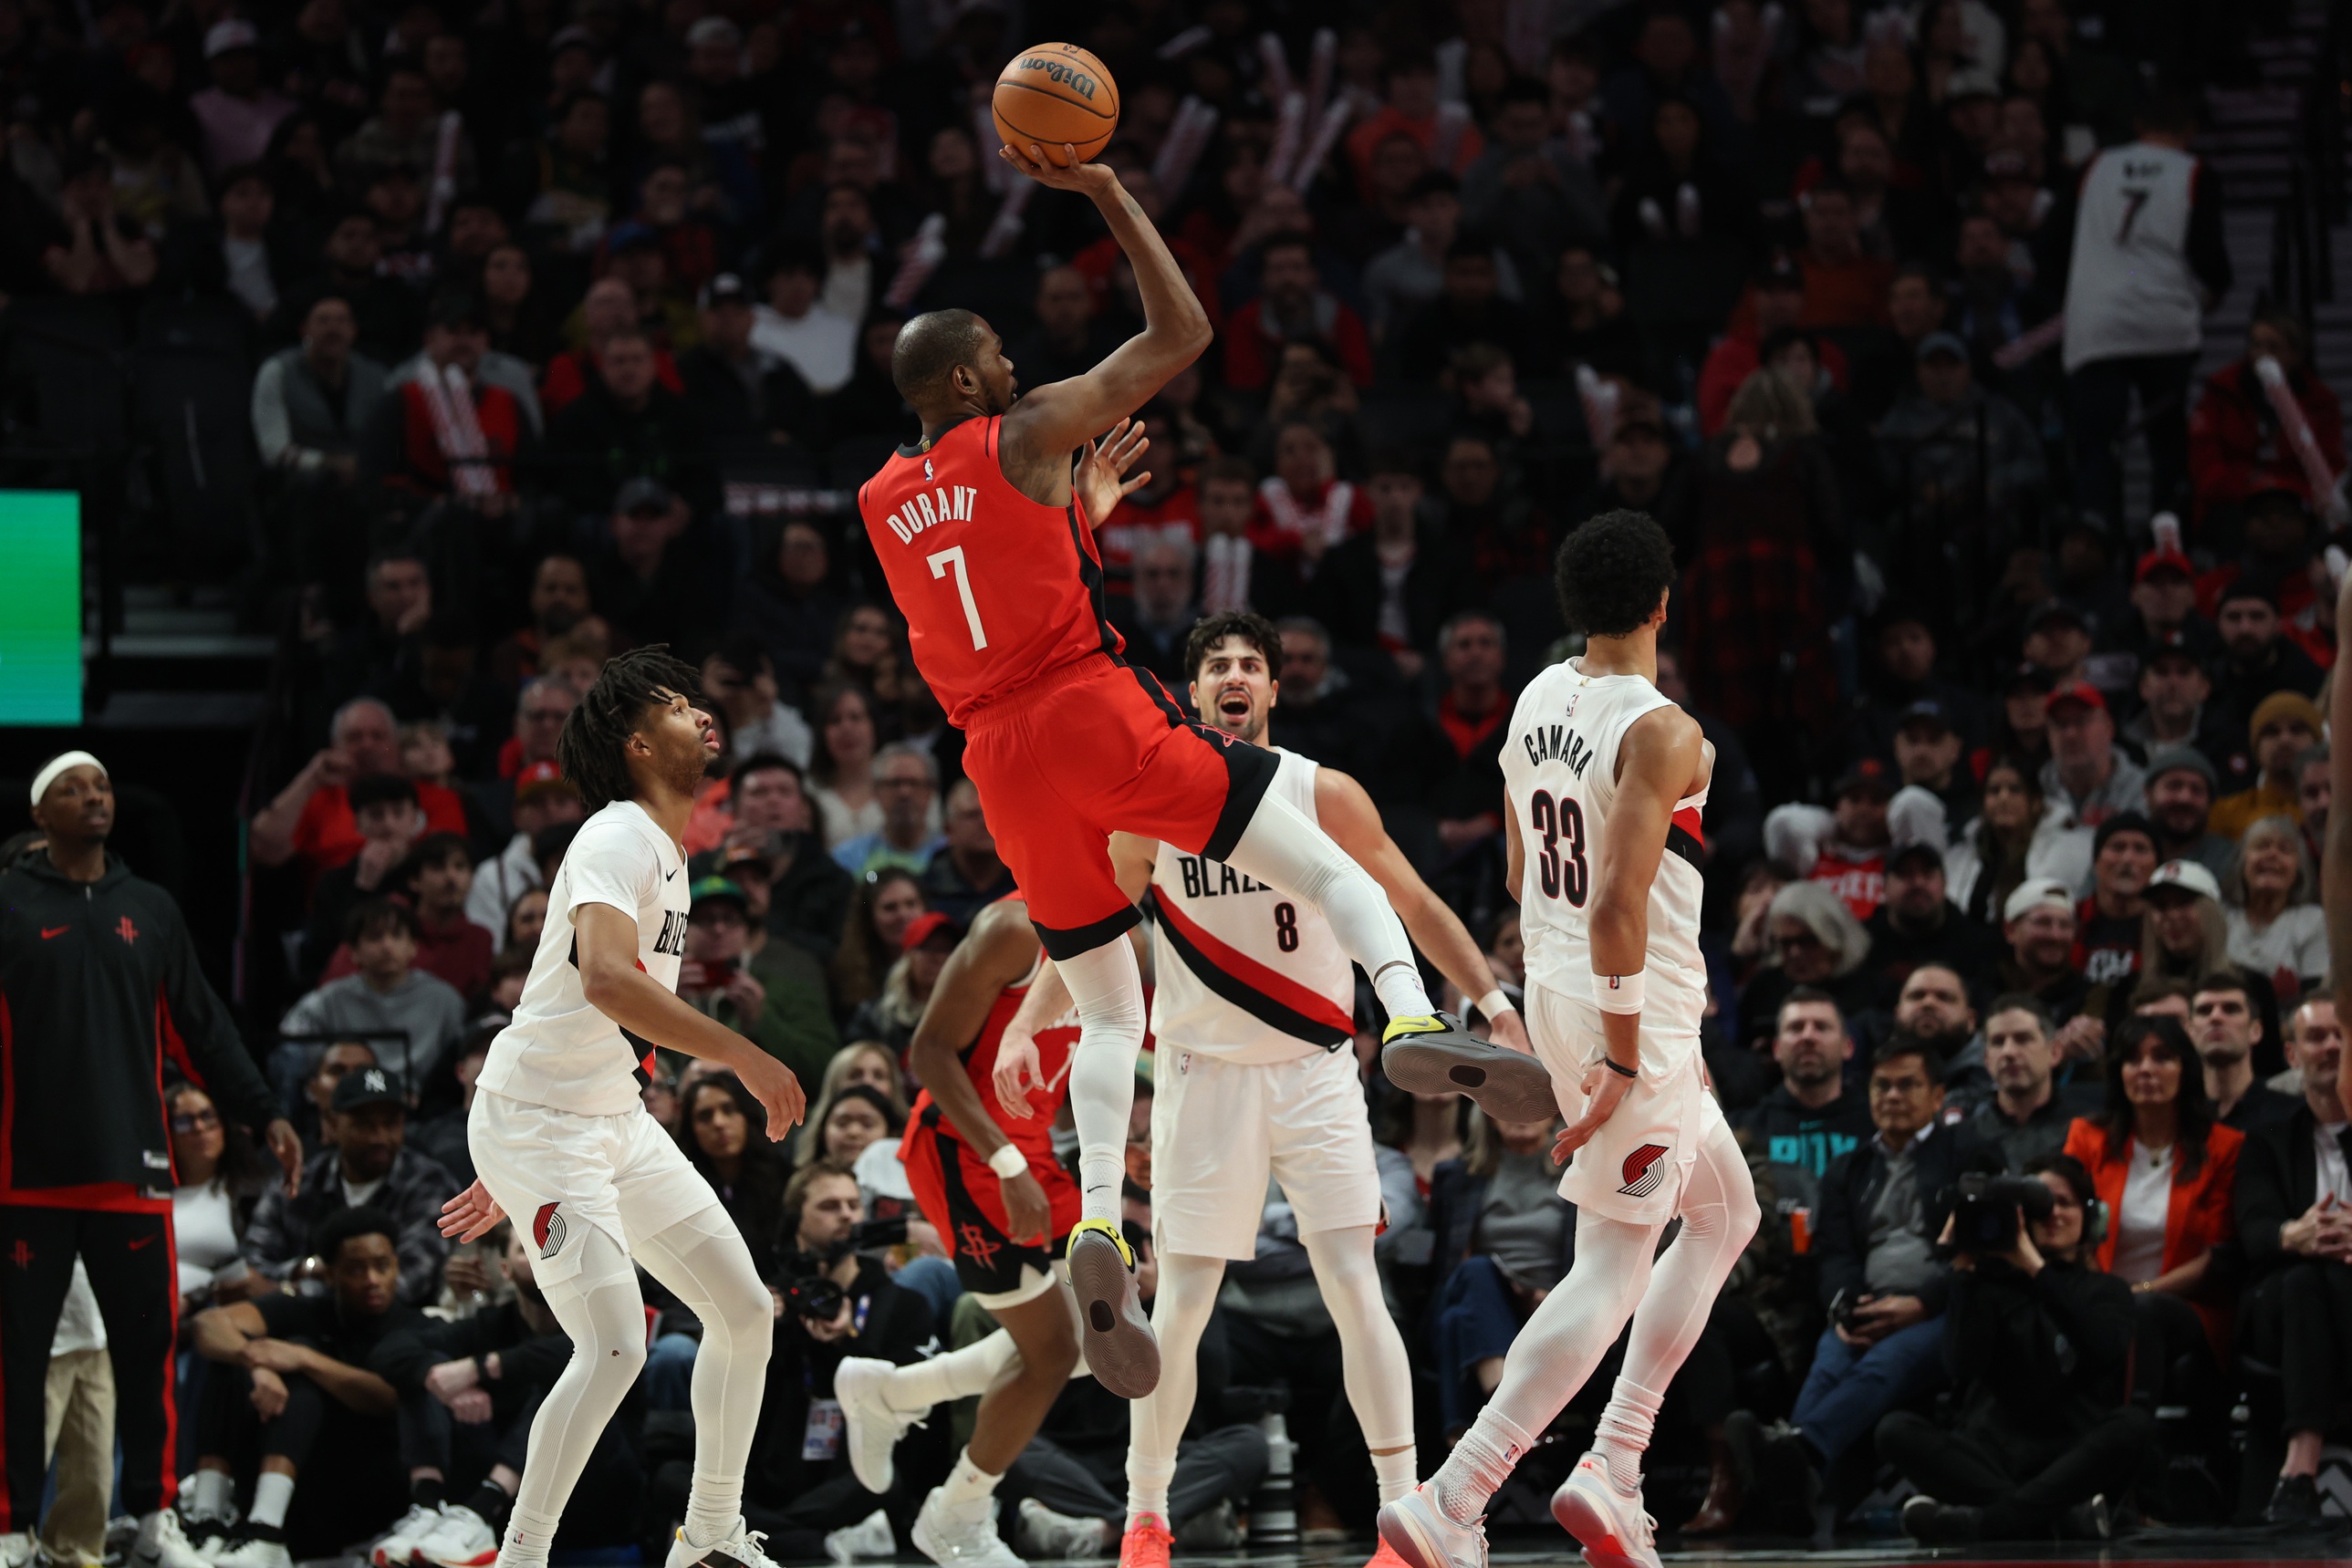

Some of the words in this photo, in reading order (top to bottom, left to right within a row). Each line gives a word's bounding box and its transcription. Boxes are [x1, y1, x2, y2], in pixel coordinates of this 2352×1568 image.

[1019, 57, 1097, 101] Wilson
[2117, 186, 2151, 245] 7
[886, 484, 977, 545] DURANT
[925, 545, 988, 652] 7
[1525, 724, 1593, 782] CAMARA
[1531, 788, 1588, 909] 33
[1275, 901, 1299, 953] 8
